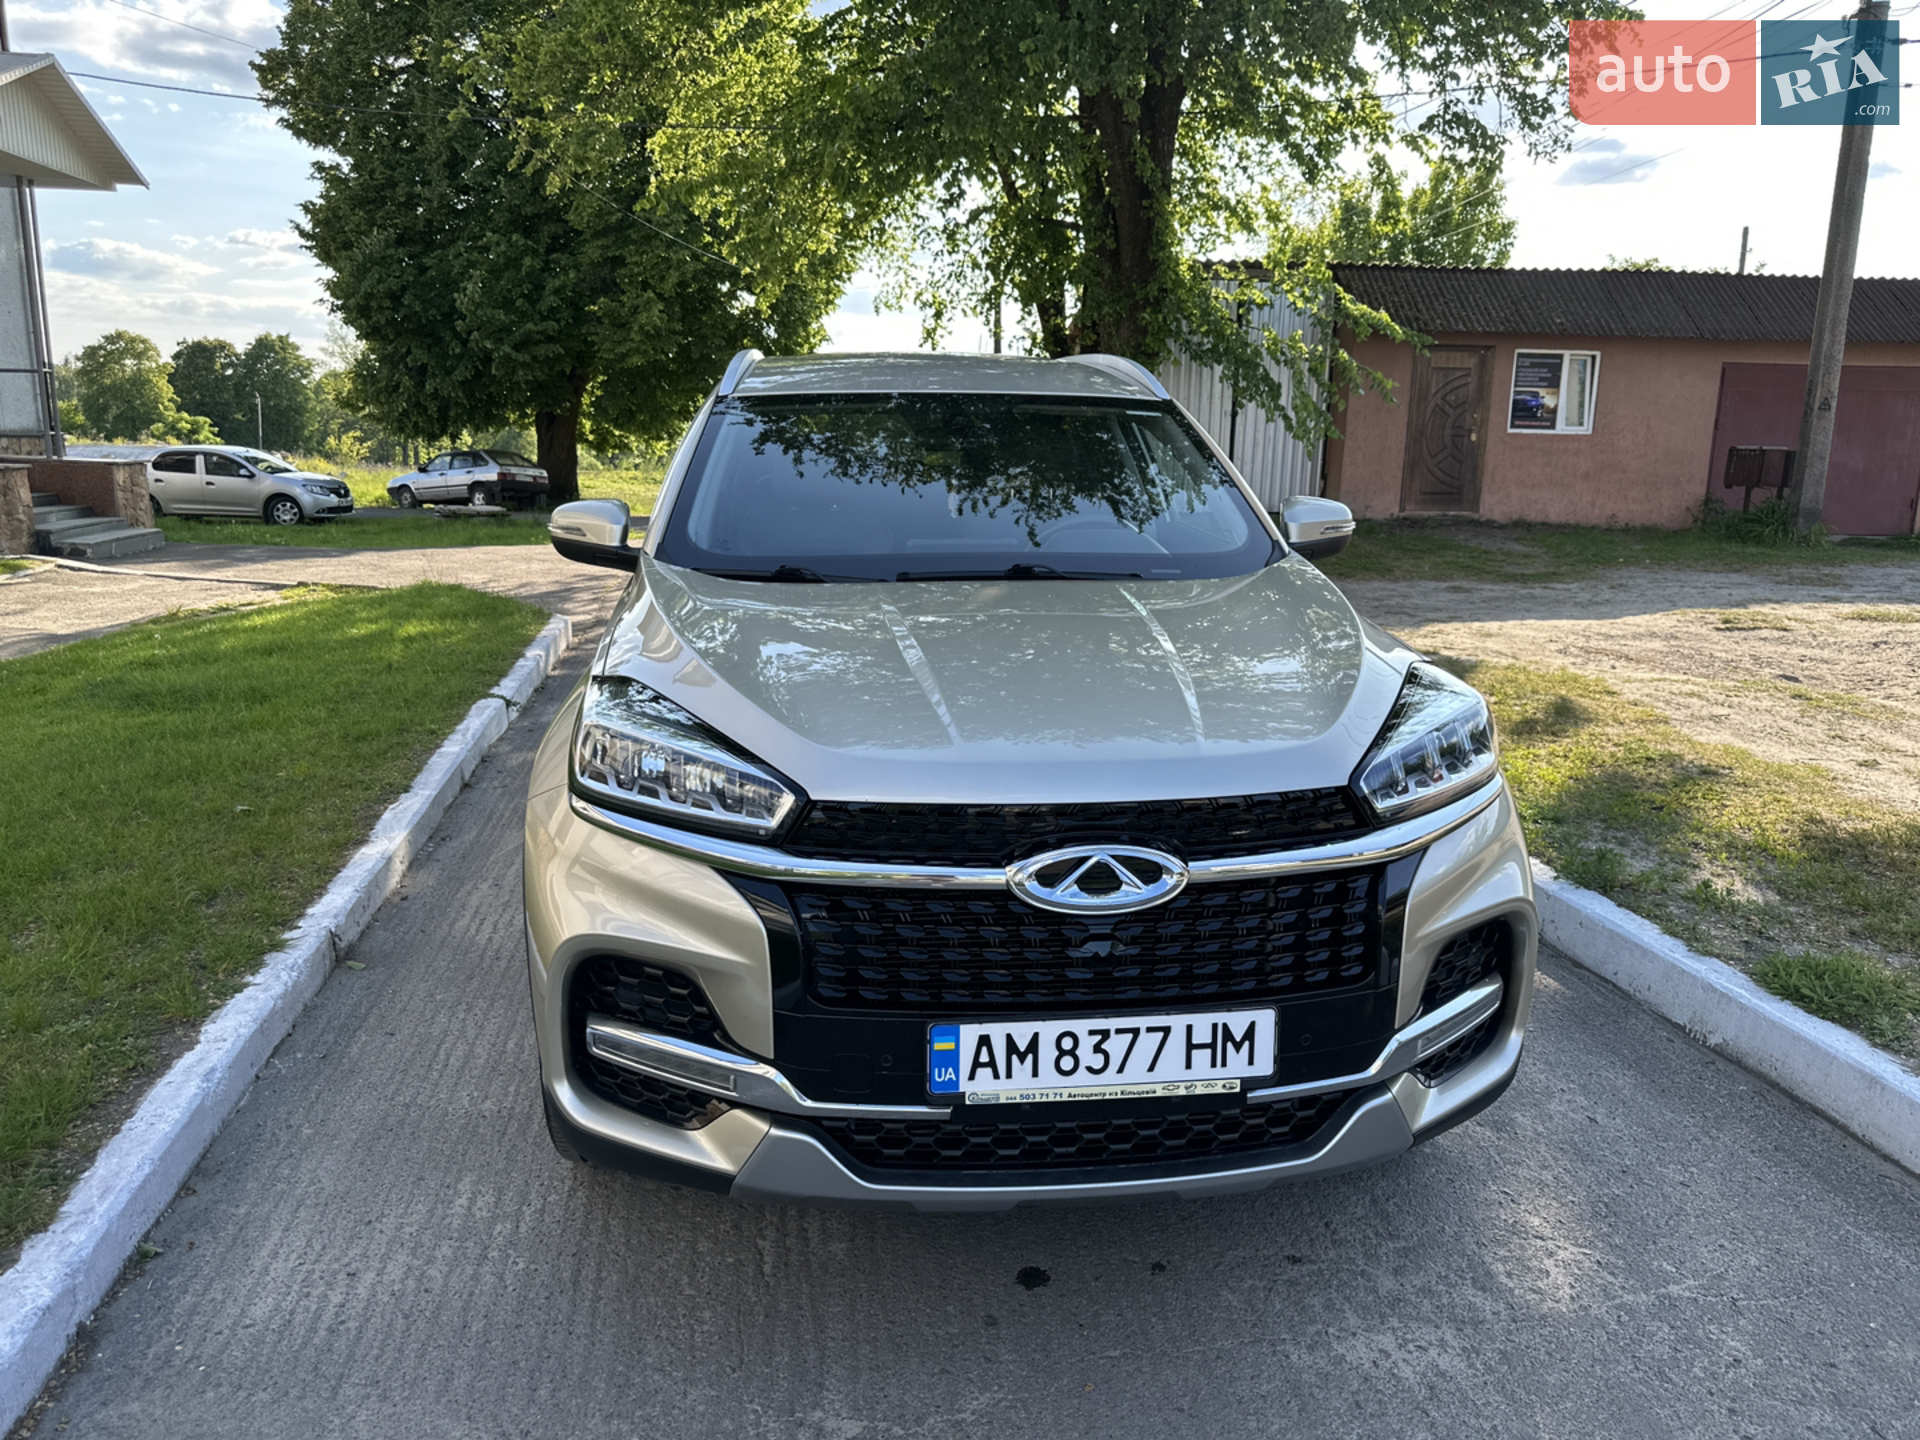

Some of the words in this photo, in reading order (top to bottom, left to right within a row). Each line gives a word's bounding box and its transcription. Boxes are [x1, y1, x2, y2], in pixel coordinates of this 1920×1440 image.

[967, 1031, 1040, 1081] AM
[1054, 1025, 1172, 1077] 8377
[1184, 1020, 1257, 1071] HM
[934, 1067, 957, 1083] UA
[1019, 1092, 1036, 1101] 503
[1038, 1092, 1049, 1100] 71
[1052, 1091, 1063, 1099] 71
[1067, 1091, 1108, 1100] Автоцентр
